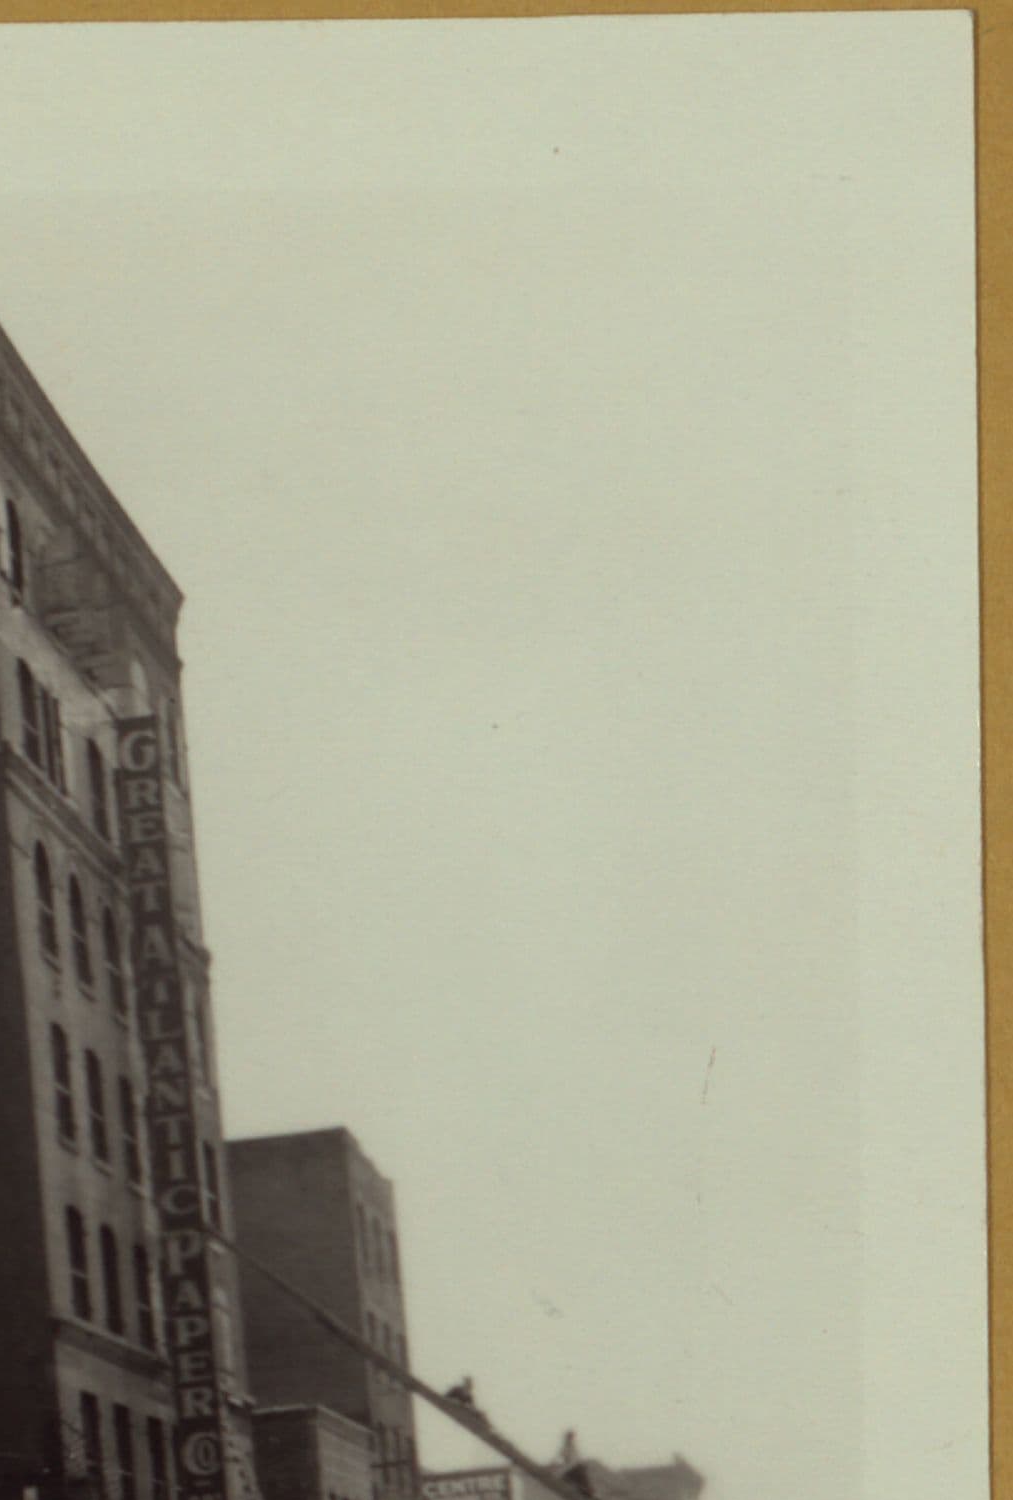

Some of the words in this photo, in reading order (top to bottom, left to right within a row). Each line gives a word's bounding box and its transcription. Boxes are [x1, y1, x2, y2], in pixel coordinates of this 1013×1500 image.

[120, 729, 170, 913] GREAT
[141, 923, 203, 1214] ATLANTIC
[166, 1229, 215, 1420] PAPER
